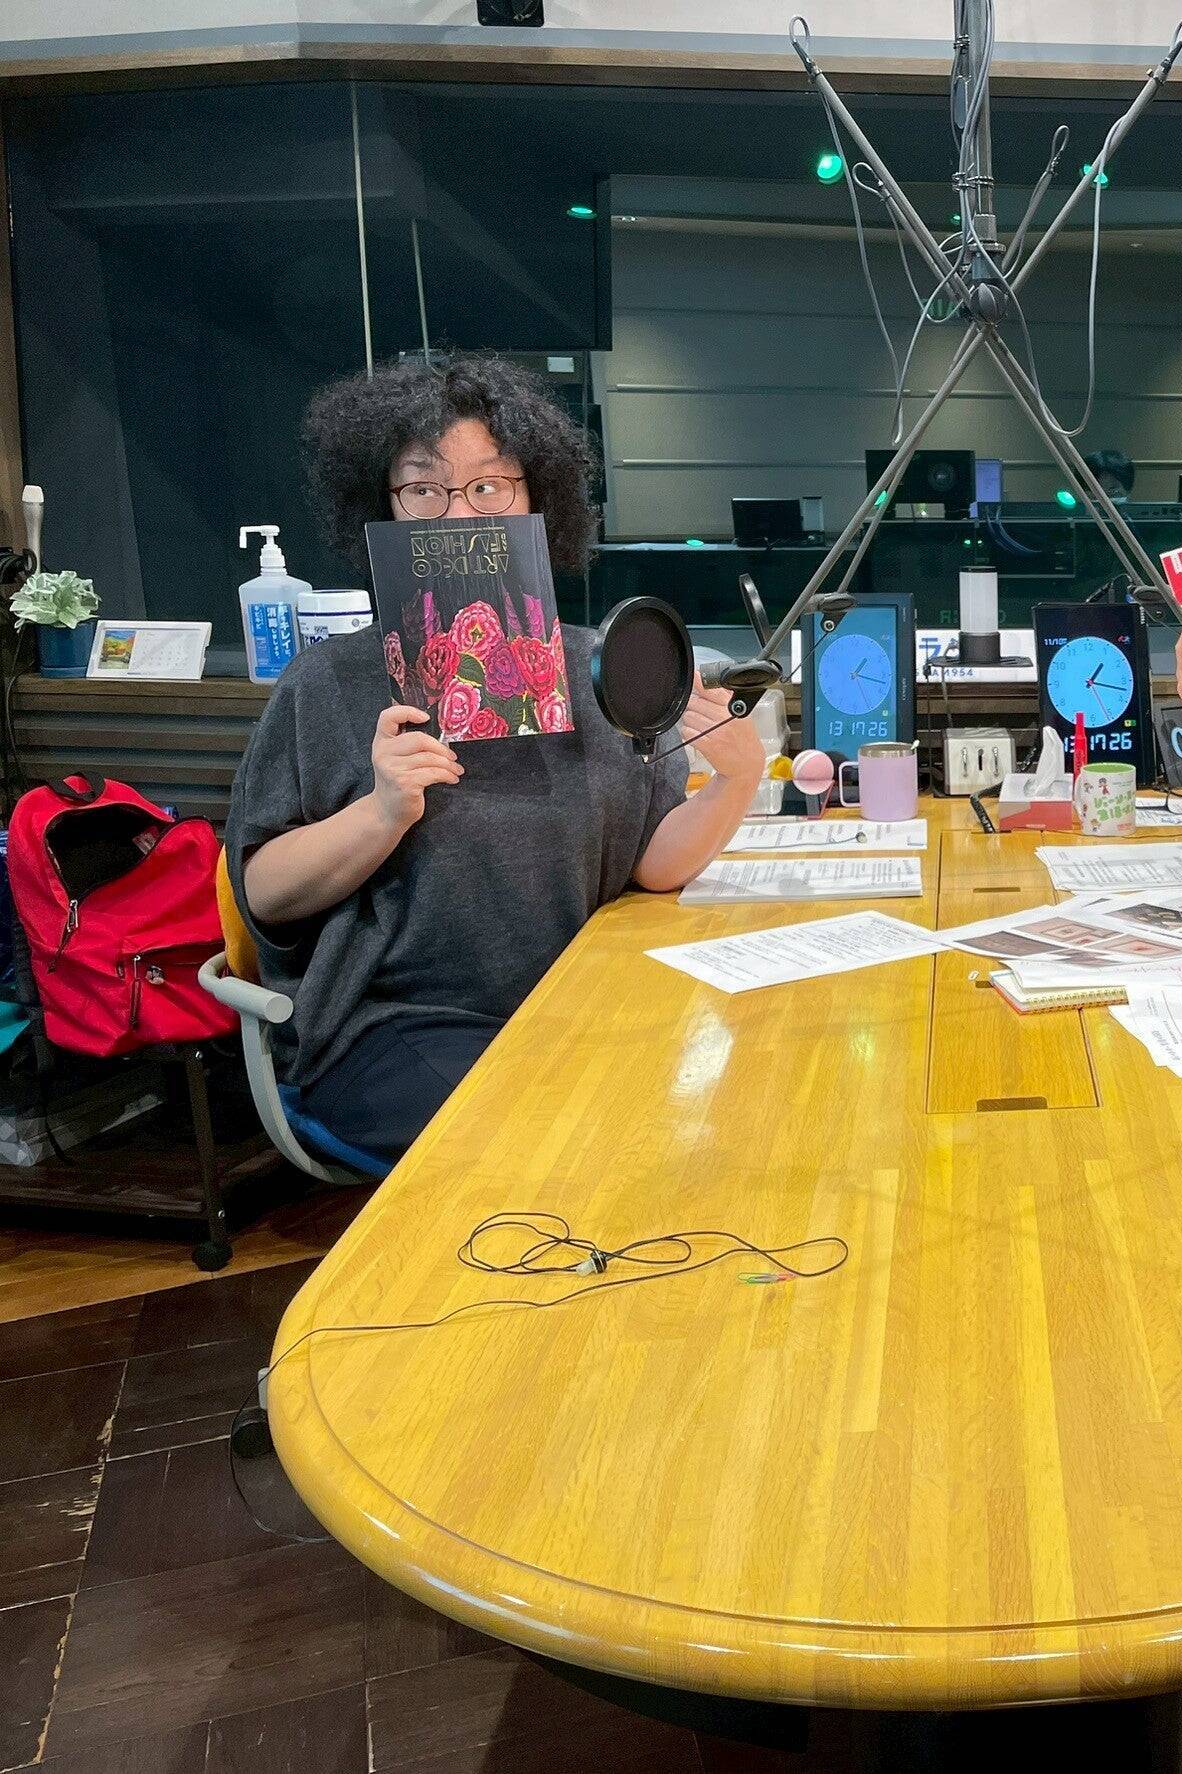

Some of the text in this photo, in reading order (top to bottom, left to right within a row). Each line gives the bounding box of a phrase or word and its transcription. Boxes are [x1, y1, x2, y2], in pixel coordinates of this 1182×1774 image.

[411, 533, 501, 557] FASHION
[474, 554, 509, 575] ART
[829, 720, 888, 737] 13 17 26
[1090, 733, 1107, 751] 17
[1109, 732, 1132, 751] 26
